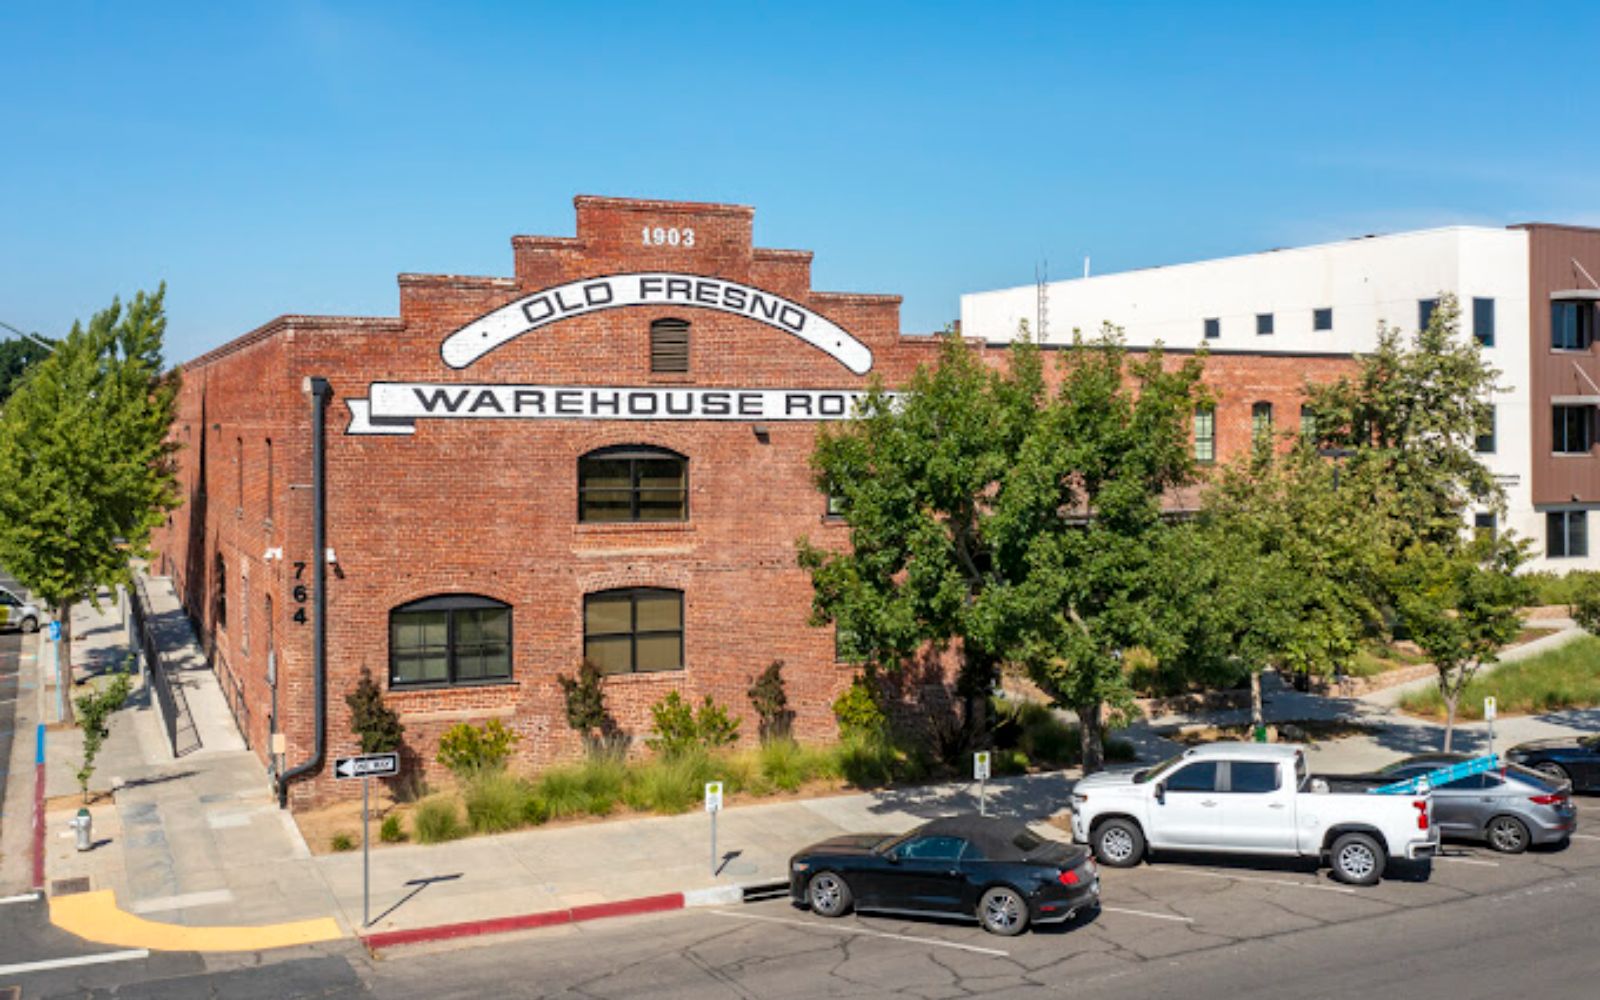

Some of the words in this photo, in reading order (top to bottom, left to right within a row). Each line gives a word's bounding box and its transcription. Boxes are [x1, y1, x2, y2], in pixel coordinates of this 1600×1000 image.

[642, 227, 695, 247] 1903
[522, 281, 613, 323] OLD
[639, 277, 806, 332] FRESNO
[413, 387, 764, 415] WAREHOUSE
[293, 562, 307, 624] 764
